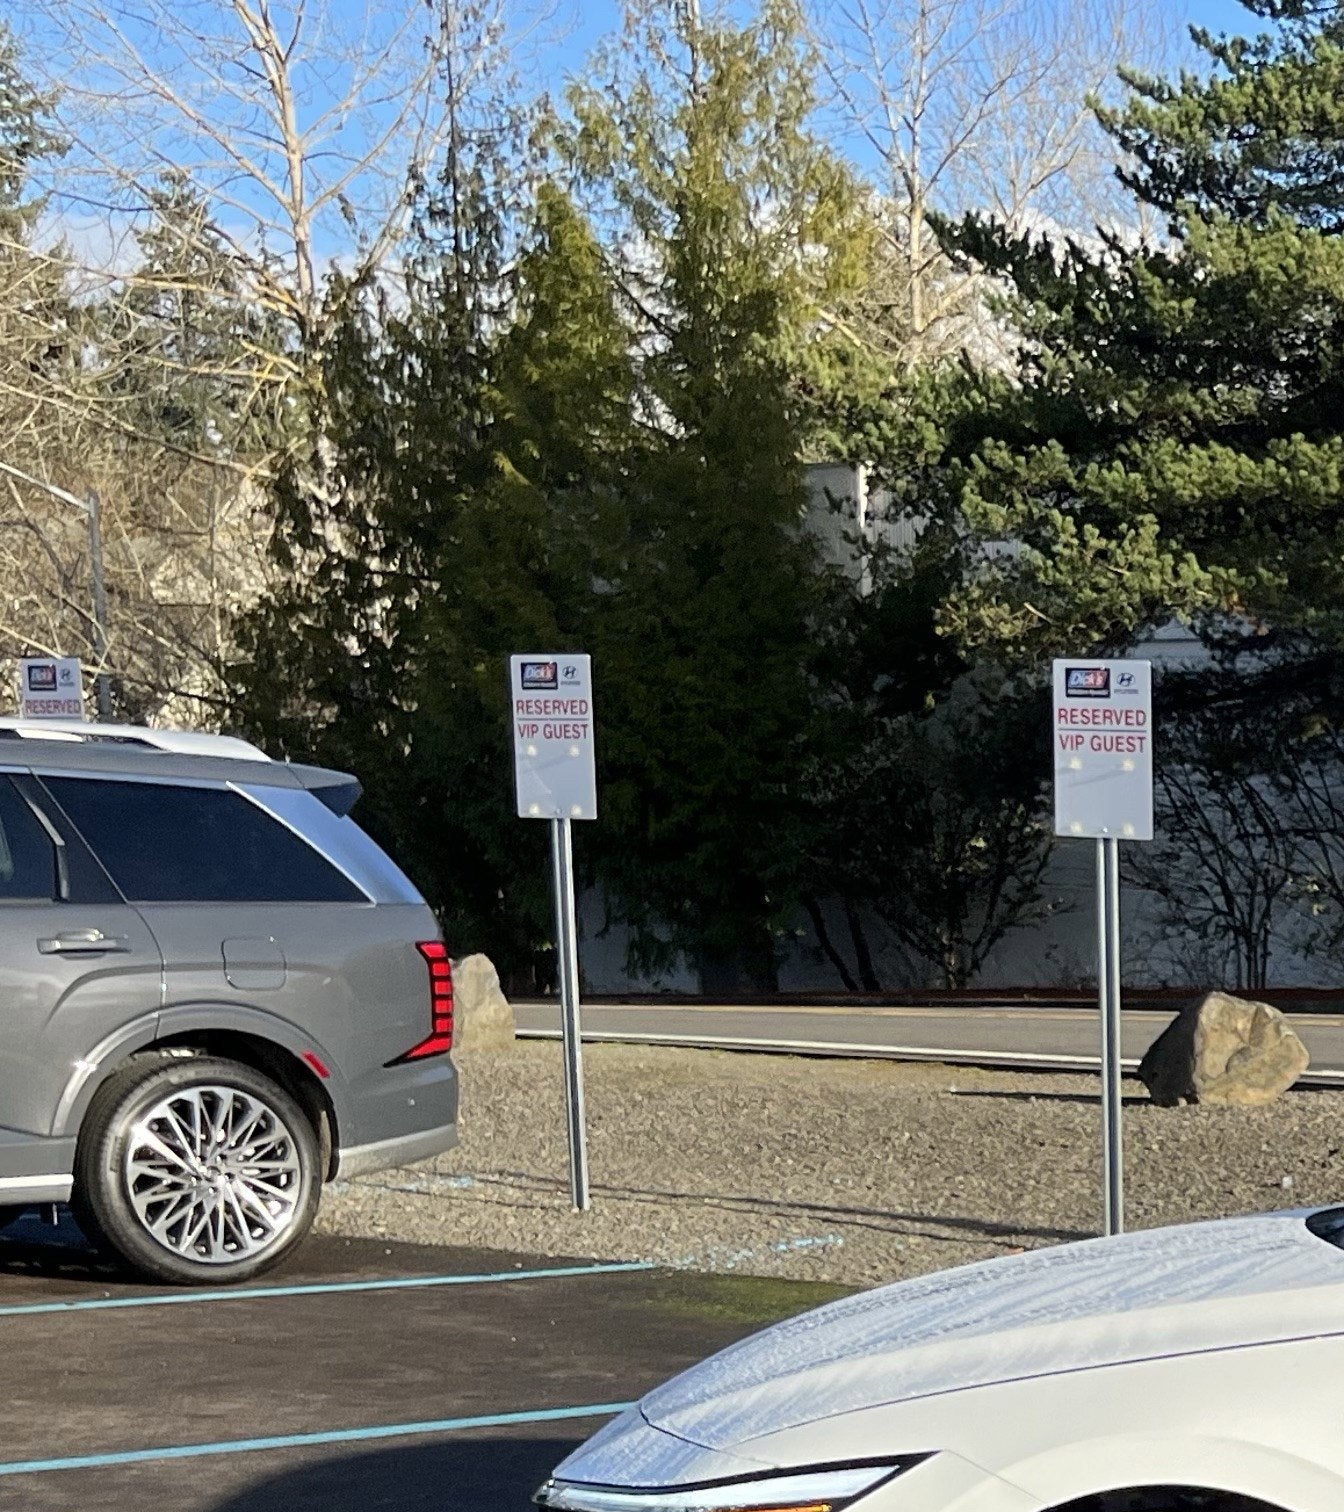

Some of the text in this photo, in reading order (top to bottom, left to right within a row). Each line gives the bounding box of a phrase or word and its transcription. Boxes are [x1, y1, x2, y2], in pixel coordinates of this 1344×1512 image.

[25, 699, 81, 714] RESERVED
[515, 700, 589, 716] RESERVED
[1057, 707, 1147, 726] RESERVED
[517, 723, 590, 740] VIP GUEST
[1058, 734, 1147, 753] VIP GUEST
